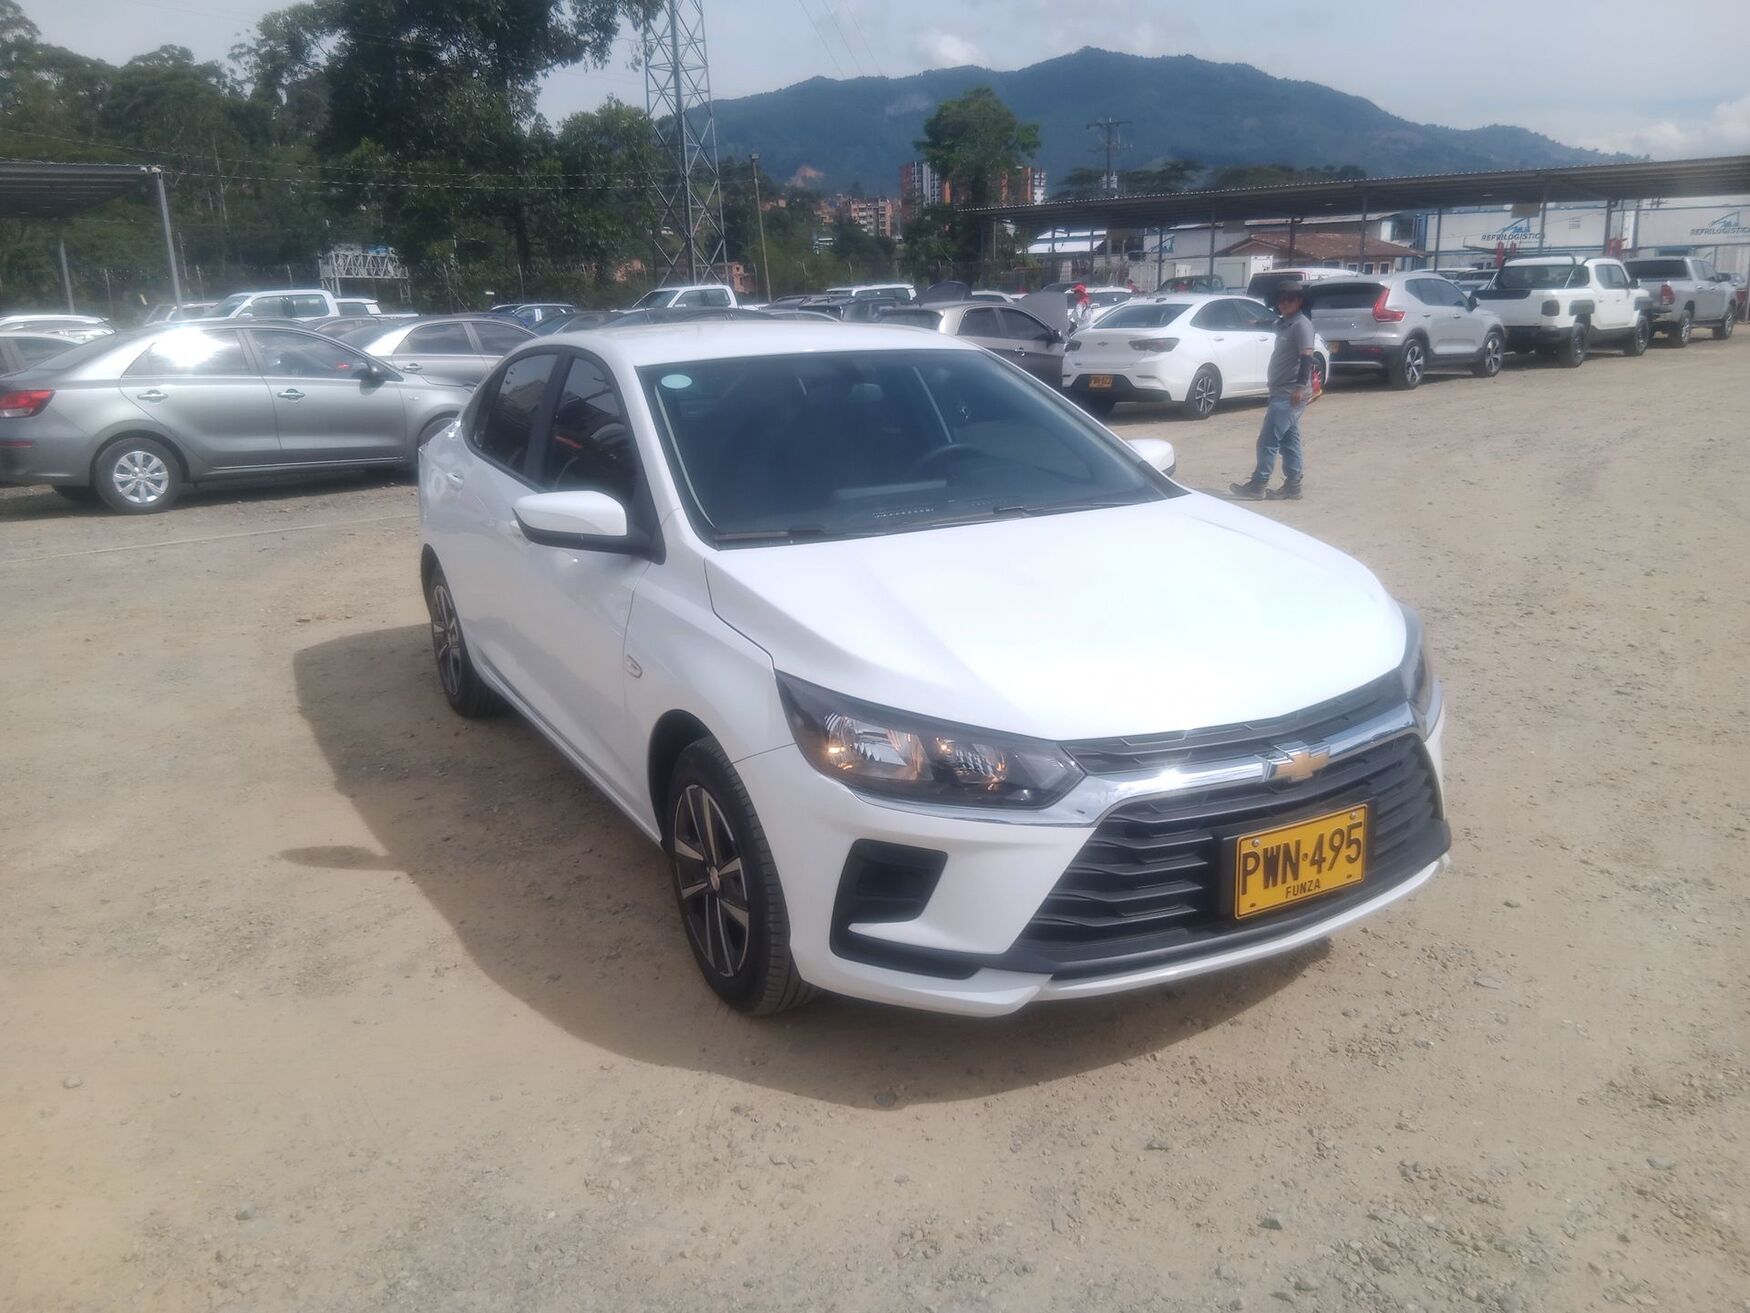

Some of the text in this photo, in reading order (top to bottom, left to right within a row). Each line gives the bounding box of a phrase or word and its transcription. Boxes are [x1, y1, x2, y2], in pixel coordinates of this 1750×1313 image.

[1690, 227, 1750, 236] REFRILOGISTIC
[1481, 232, 1545, 241] REFRILOGISTIC
[1285, 878, 1321, 899] FUNZA
